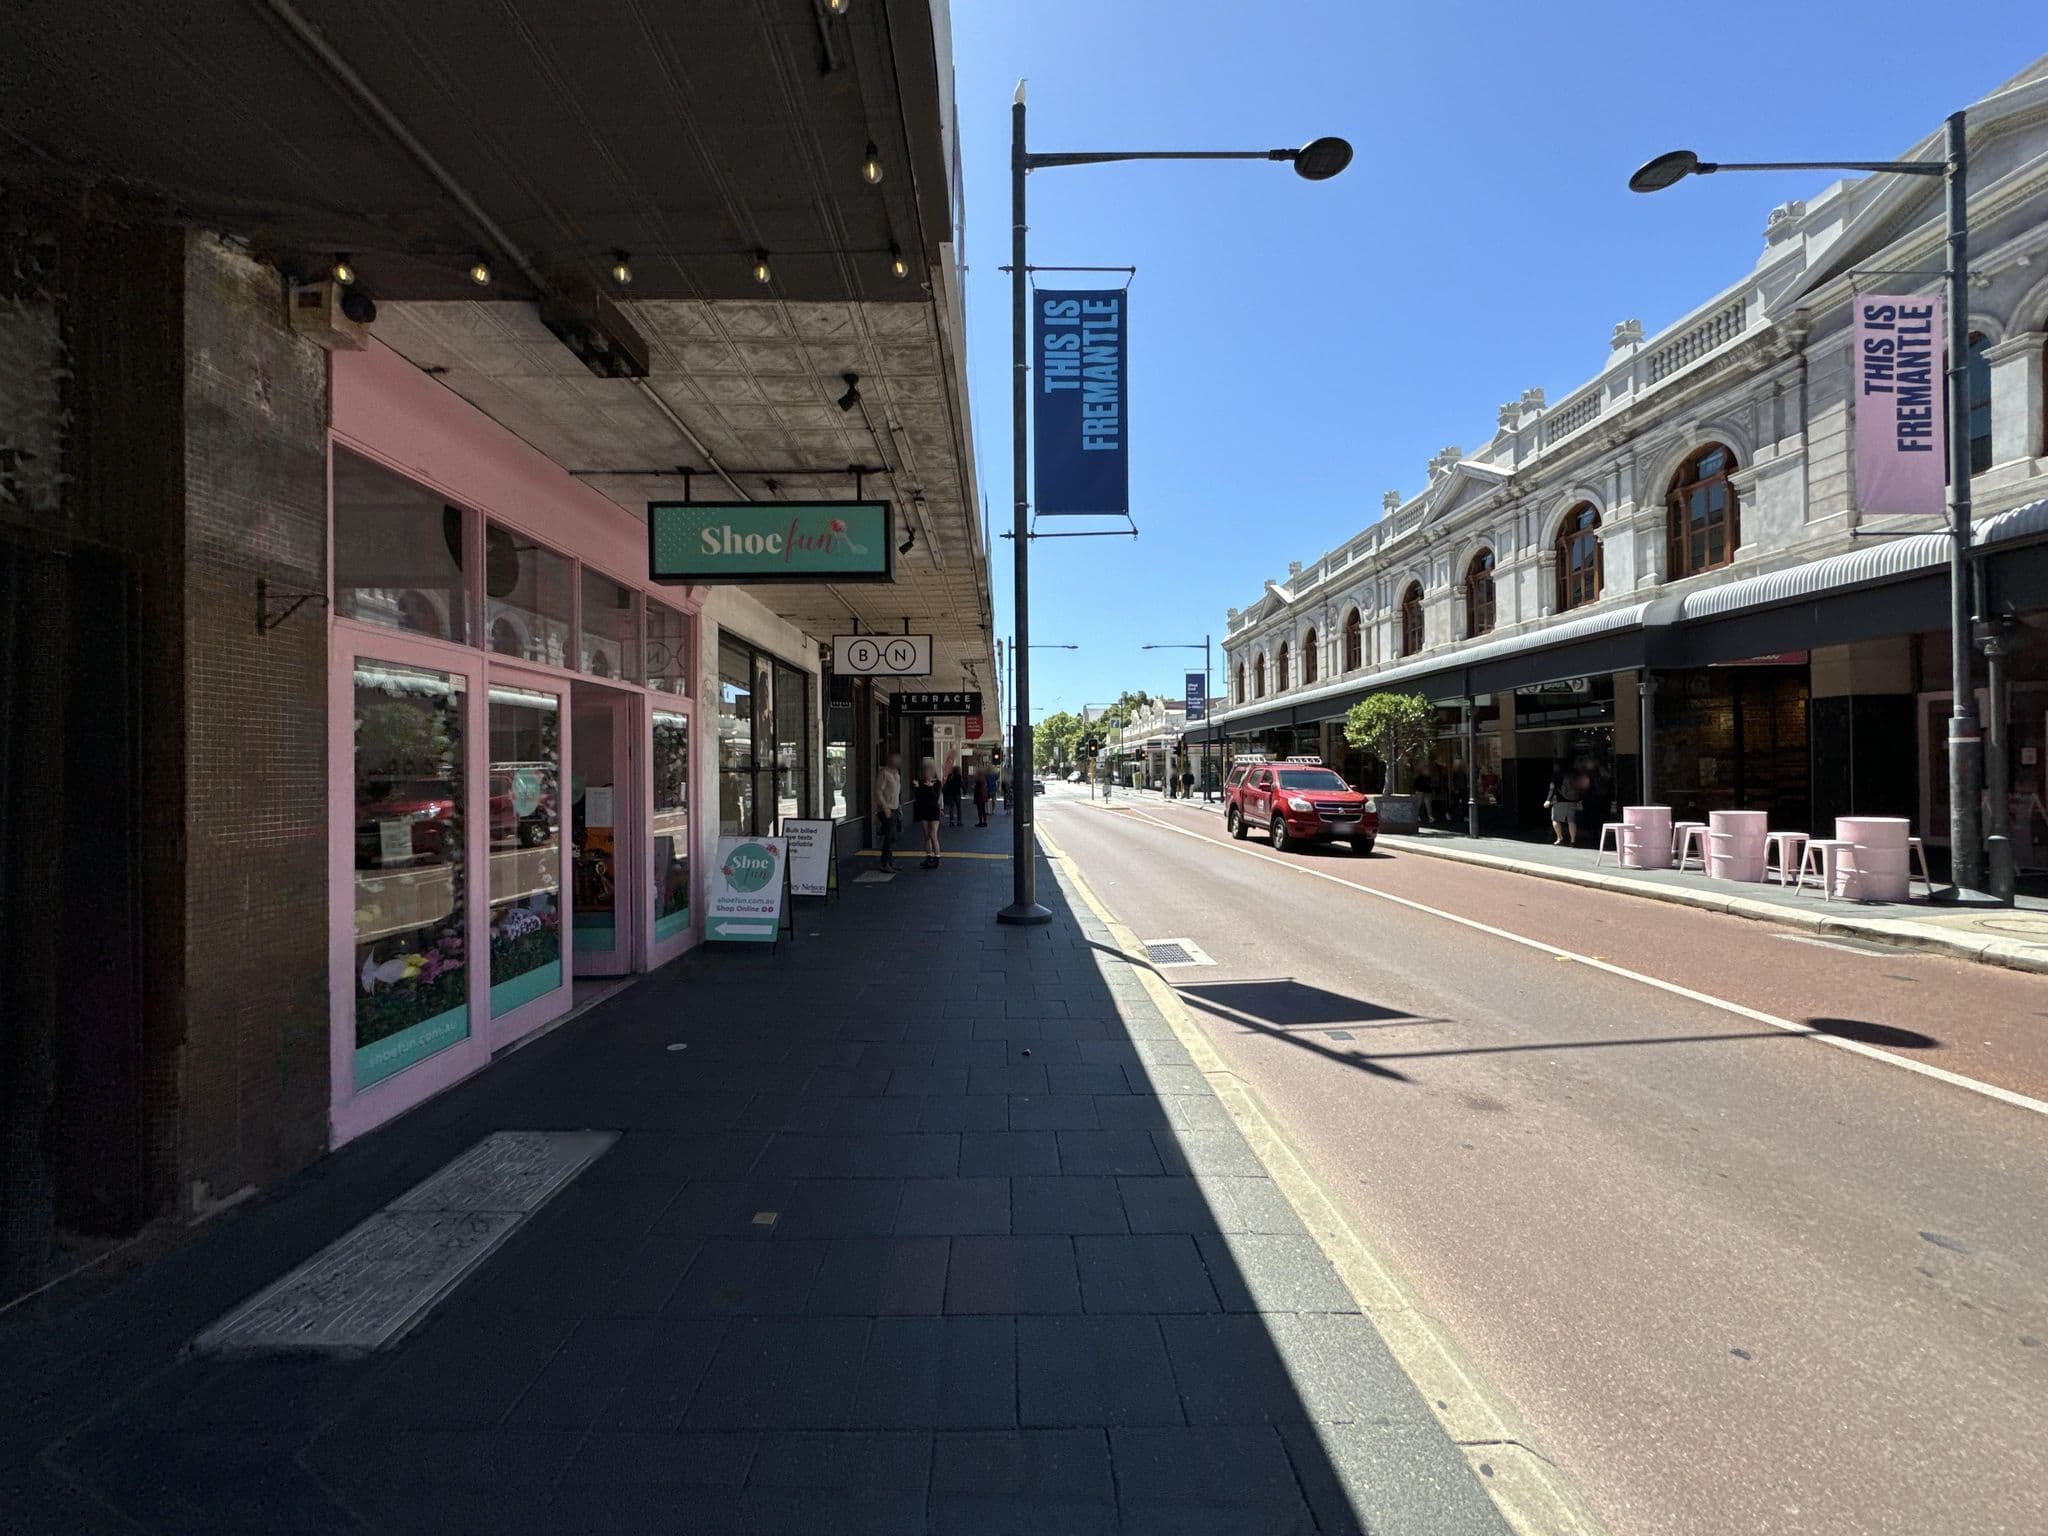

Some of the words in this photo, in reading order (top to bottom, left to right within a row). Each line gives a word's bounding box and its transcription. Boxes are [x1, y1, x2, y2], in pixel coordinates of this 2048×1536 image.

[1043, 299, 1080, 326] IS
[1864, 304, 1896, 330] IS
[1043, 333, 1080, 393] THIS
[1082, 299, 1118, 450] FREMANTLE
[1864, 338, 1895, 395] THIS
[1897, 305, 1933, 452] FREMANTLE
[858, 649, 868, 662] B
[894, 649, 906, 662] N
[902, 694, 971, 703] TERRACE
[732, 855, 769, 870] Shoe
[716, 905, 735, 913] Shop
[736, 905, 760, 913] Online
